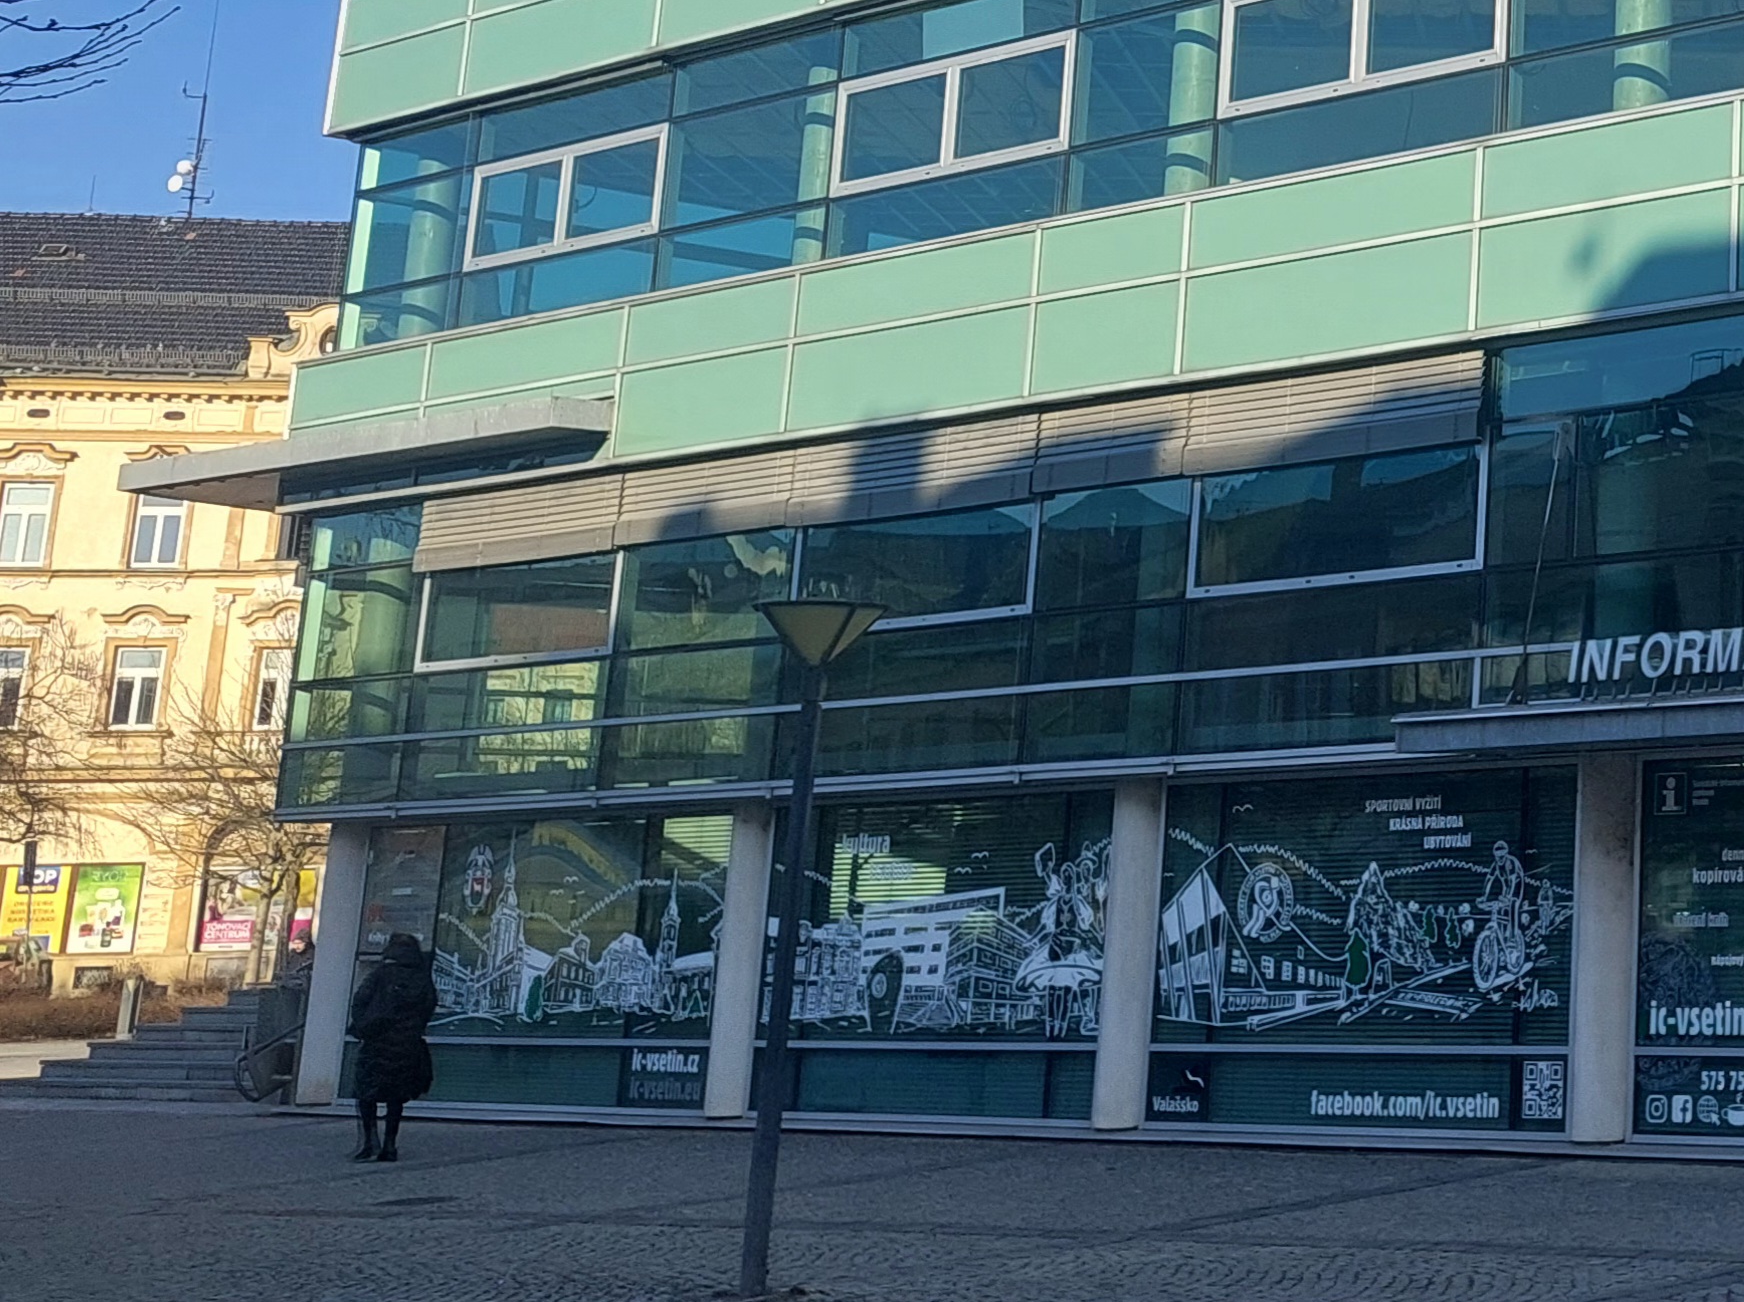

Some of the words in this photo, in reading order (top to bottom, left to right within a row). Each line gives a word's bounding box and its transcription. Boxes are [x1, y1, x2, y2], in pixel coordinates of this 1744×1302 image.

[1364, 796, 1414, 813] SPORTOVNÍ
[1388, 814, 1423, 831] KRÁSNÁ
[1424, 813, 1464, 829] PŘÍRODA
[842, 833, 891, 854] kultura
[1423, 832, 1472, 849] UBYTOVÁNÍ
[20, 869, 57, 886] OP
[631, 1048, 700, 1073] ic-vsetin.cz
[628, 1076, 701, 1101] ic-vsetin.eu
[1701, 1070, 1725, 1092] 575
[1152, 1095, 1200, 1114] Valašsko
[1310, 1090, 1500, 1121] facebook.com/ic.vsetin
